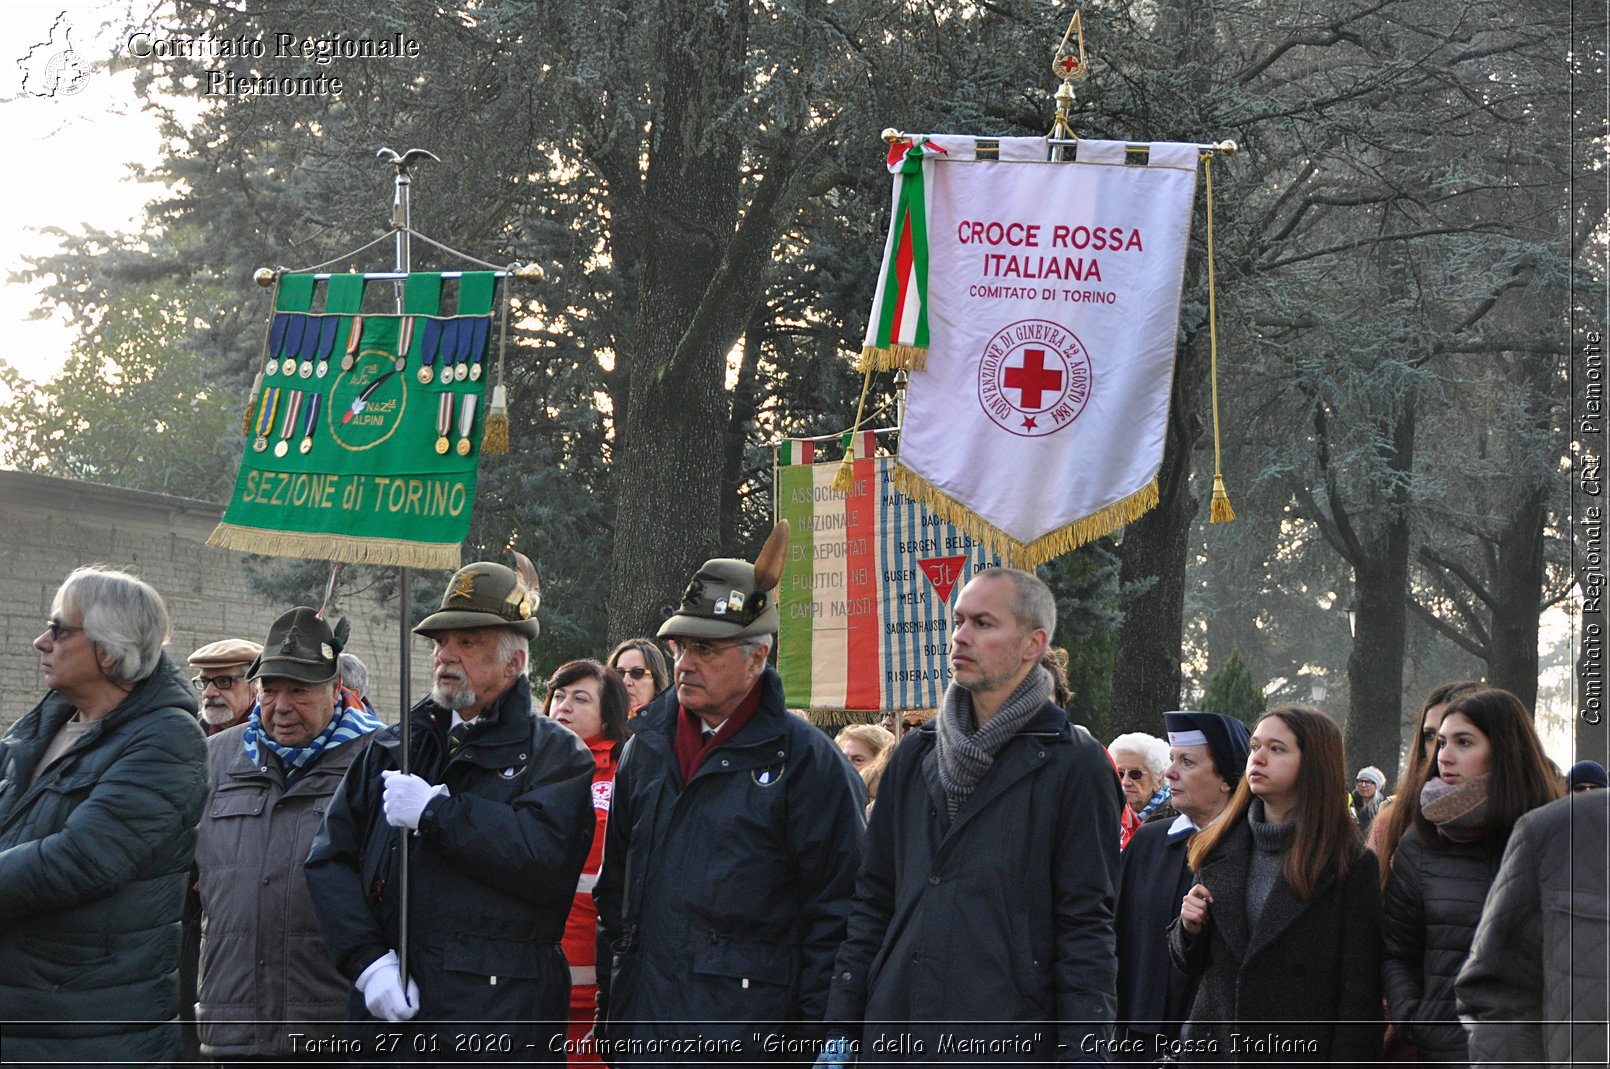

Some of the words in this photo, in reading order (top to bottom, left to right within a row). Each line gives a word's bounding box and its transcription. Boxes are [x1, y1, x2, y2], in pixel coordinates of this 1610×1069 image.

[958, 220, 1041, 247] CROCE
[1052, 225, 1143, 252] ROSSA
[983, 253, 1102, 282] ITALIANA
[969, 285, 1037, 300] COMITATO
[1042, 288, 1056, 301] DI
[1063, 290, 1116, 304] TORINO
[1000, 331, 1016, 349] DI
[1016, 324, 1066, 348] GINEVRA
[1063, 343, 1080, 359] 22
[982, 344, 1011, 420] CONVENZIONE
[1068, 361, 1087, 404] AGOSTO
[352, 414, 384, 426] ALPINI
[1050, 402, 1075, 425] 1864
[242, 470, 340, 508] SEZIONE
[343, 475, 366, 511] di
[373, 477, 467, 517] TORINO
[799, 510, 859, 532] NAZIONALE
[792, 544, 807, 562] EX
[900, 539, 937, 554] BERGEN
[792, 572, 843, 591] POLITICI
[851, 568, 868, 586] NEI
[884, 569, 916, 582] GUSEN
[790, 601, 823, 619] CAMPI
[830, 597, 872, 617] NAZISTI
[899, 592, 926, 605] MELK
[886, 618, 947, 635] SACHSENHAUSEN
[887, 669, 929, 683] RISIERA
[933, 668, 943, 680] DI
